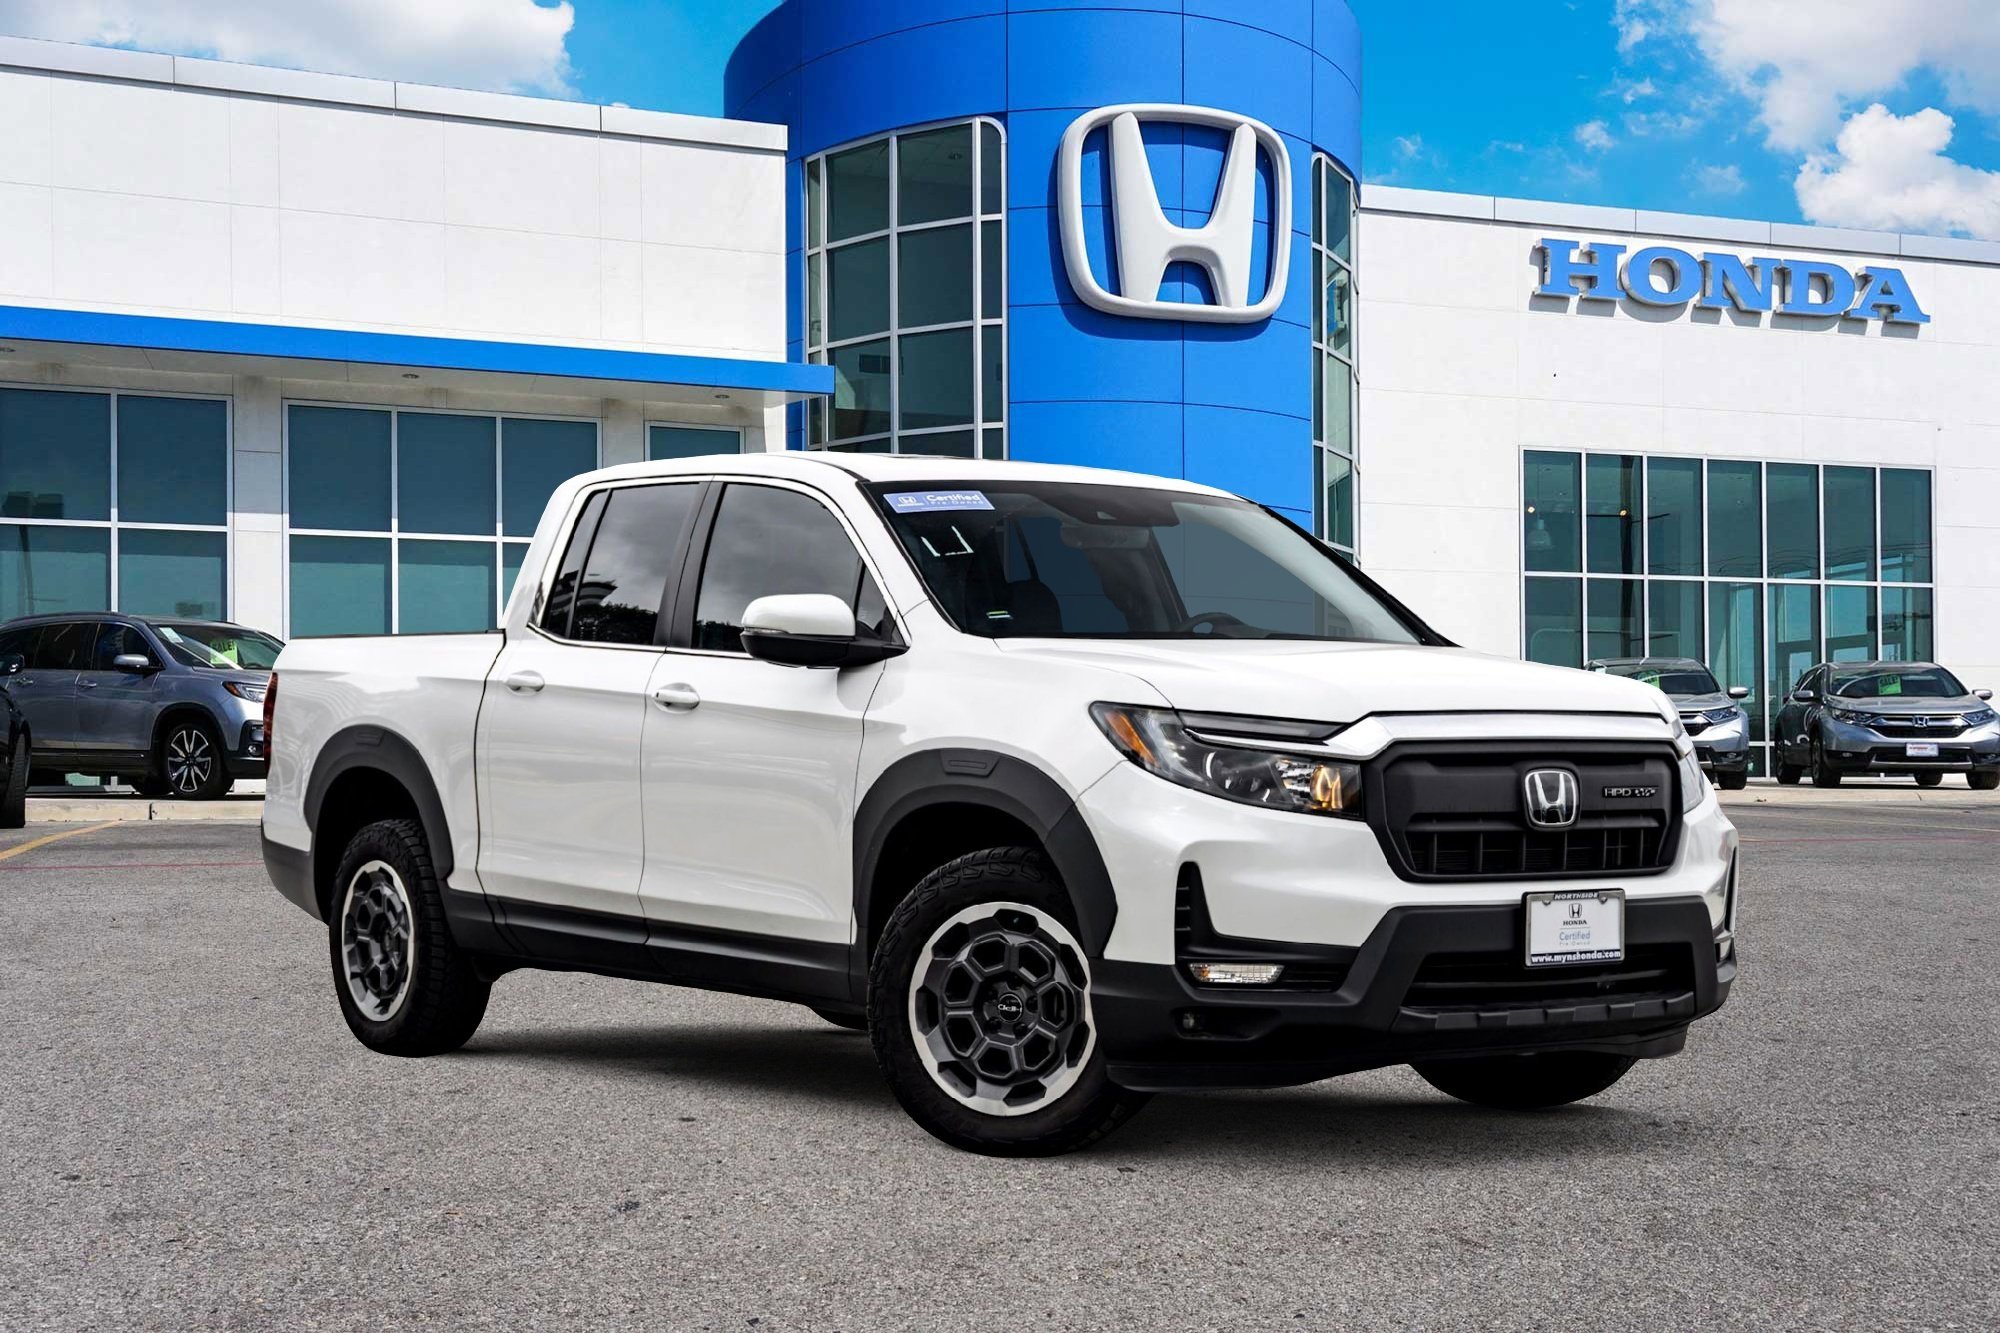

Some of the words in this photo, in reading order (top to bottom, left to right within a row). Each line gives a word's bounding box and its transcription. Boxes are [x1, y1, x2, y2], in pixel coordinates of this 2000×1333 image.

[1533, 237, 1931, 325] HONDA
[926, 494, 980, 502] Certified
[1604, 787, 1632, 797] HPD
[1554, 892, 1599, 900] NORTHSIDE
[1559, 931, 1591, 941] Certified
[1531, 950, 1621, 964] www.mynshonda.com
